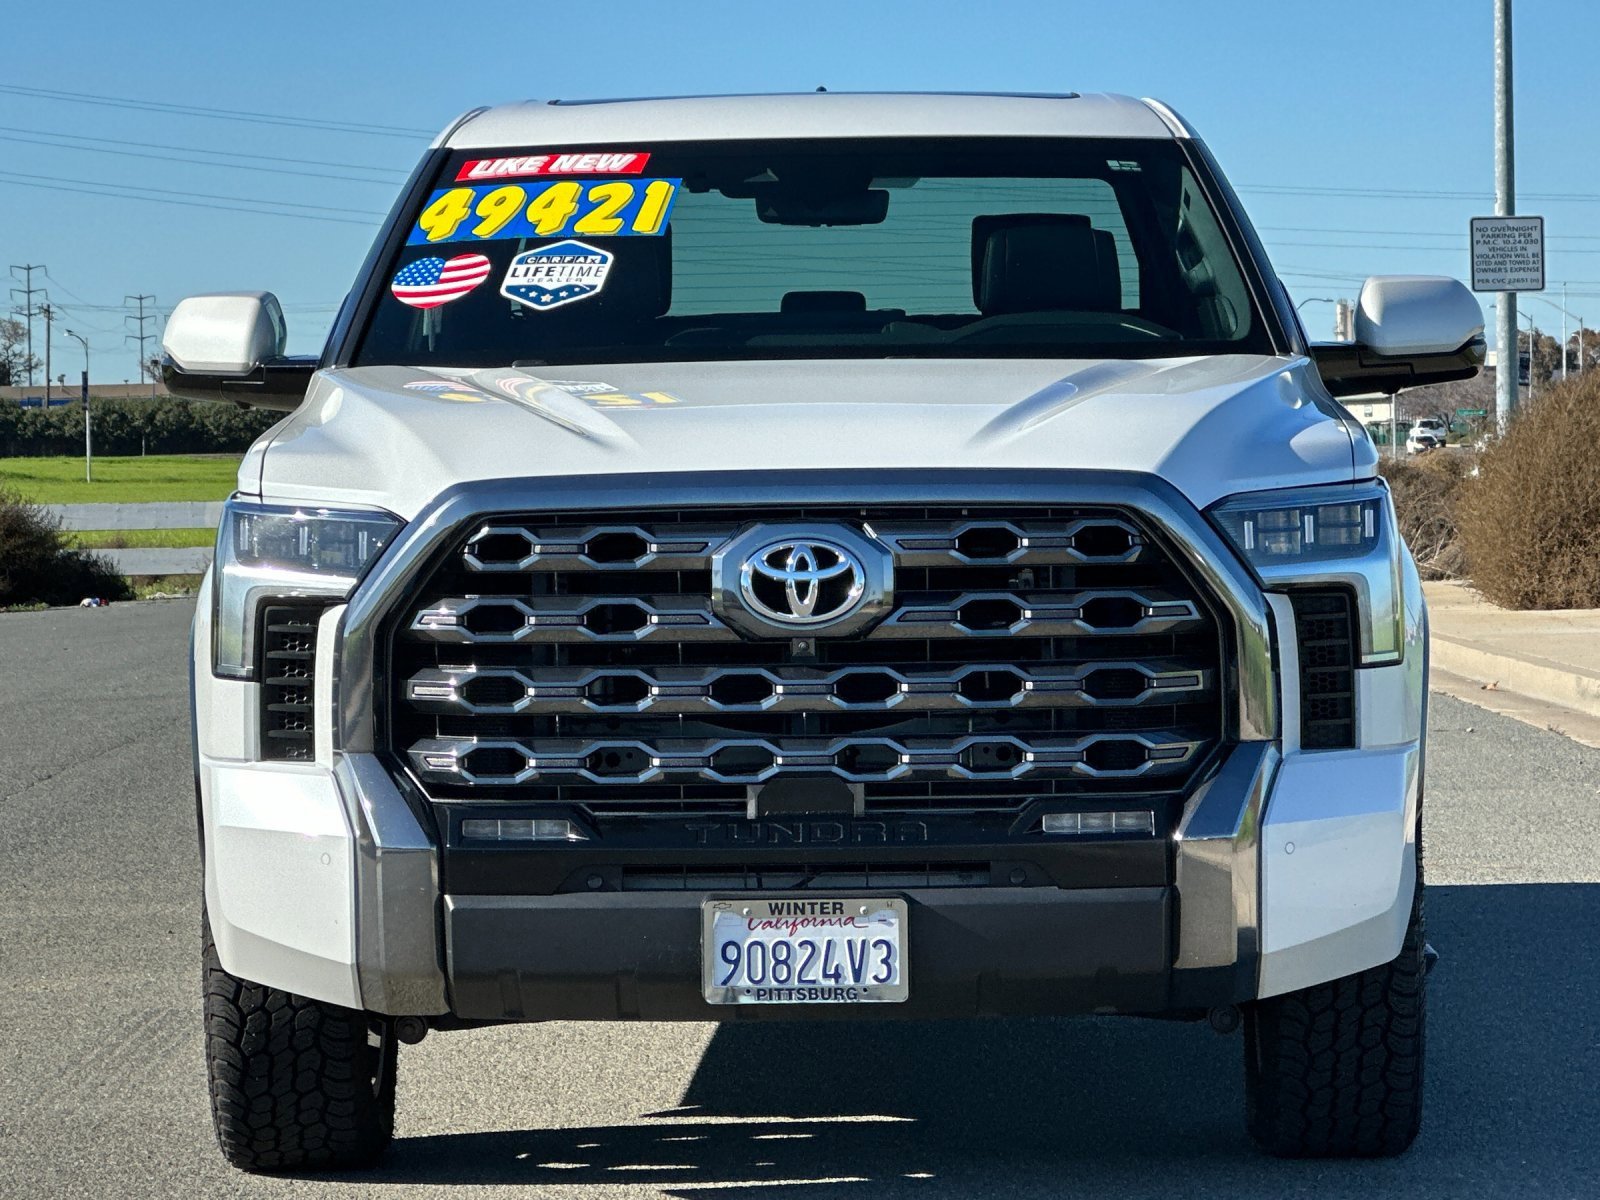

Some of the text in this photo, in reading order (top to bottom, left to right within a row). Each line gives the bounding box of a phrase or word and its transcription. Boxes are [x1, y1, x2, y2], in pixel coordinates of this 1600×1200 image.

[468, 153, 637, 177] LIKE NEW
[419, 180, 675, 242] 49421
[525, 256, 600, 264] CARFAX
[510, 266, 605, 278] LIFETIME
[685, 821, 928, 843] TUNDRA
[768, 902, 845, 916] WINTER
[747, 915, 869, 937] California
[720, 938, 893, 986] 90824V3
[756, 987, 859, 1001] PITTSBURG
